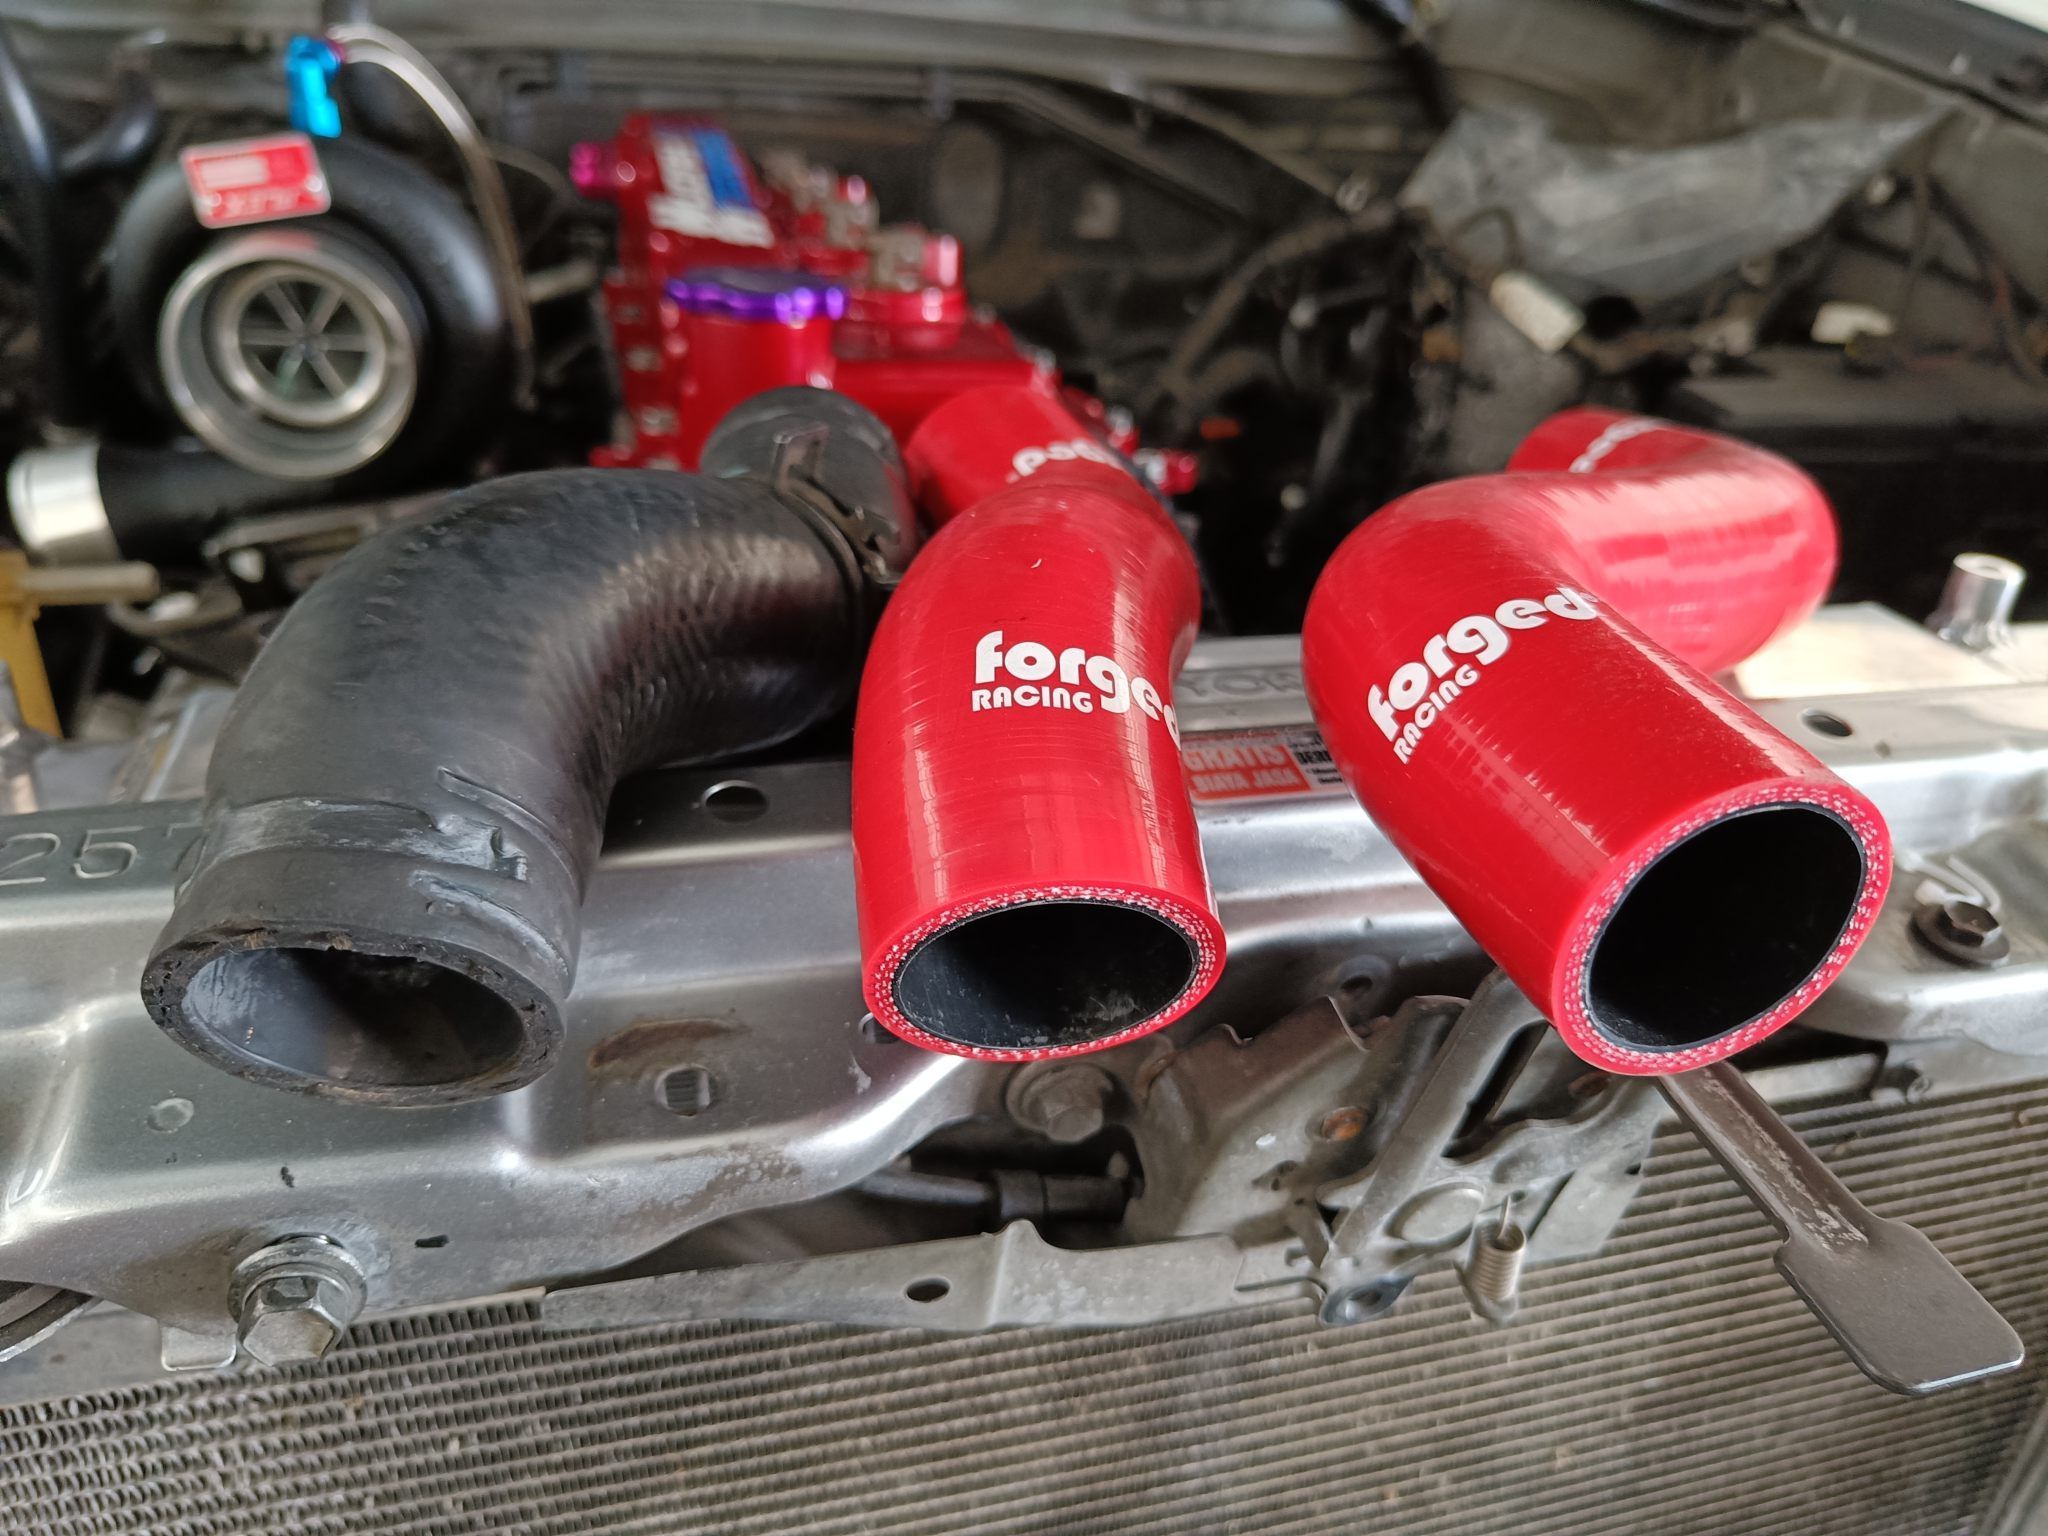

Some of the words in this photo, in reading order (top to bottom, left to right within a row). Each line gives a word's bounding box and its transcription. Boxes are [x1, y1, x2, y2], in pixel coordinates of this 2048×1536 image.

[971, 684, 1094, 714] RACING
[1367, 586, 1598, 742] forged
[1393, 664, 1479, 765] RACING
